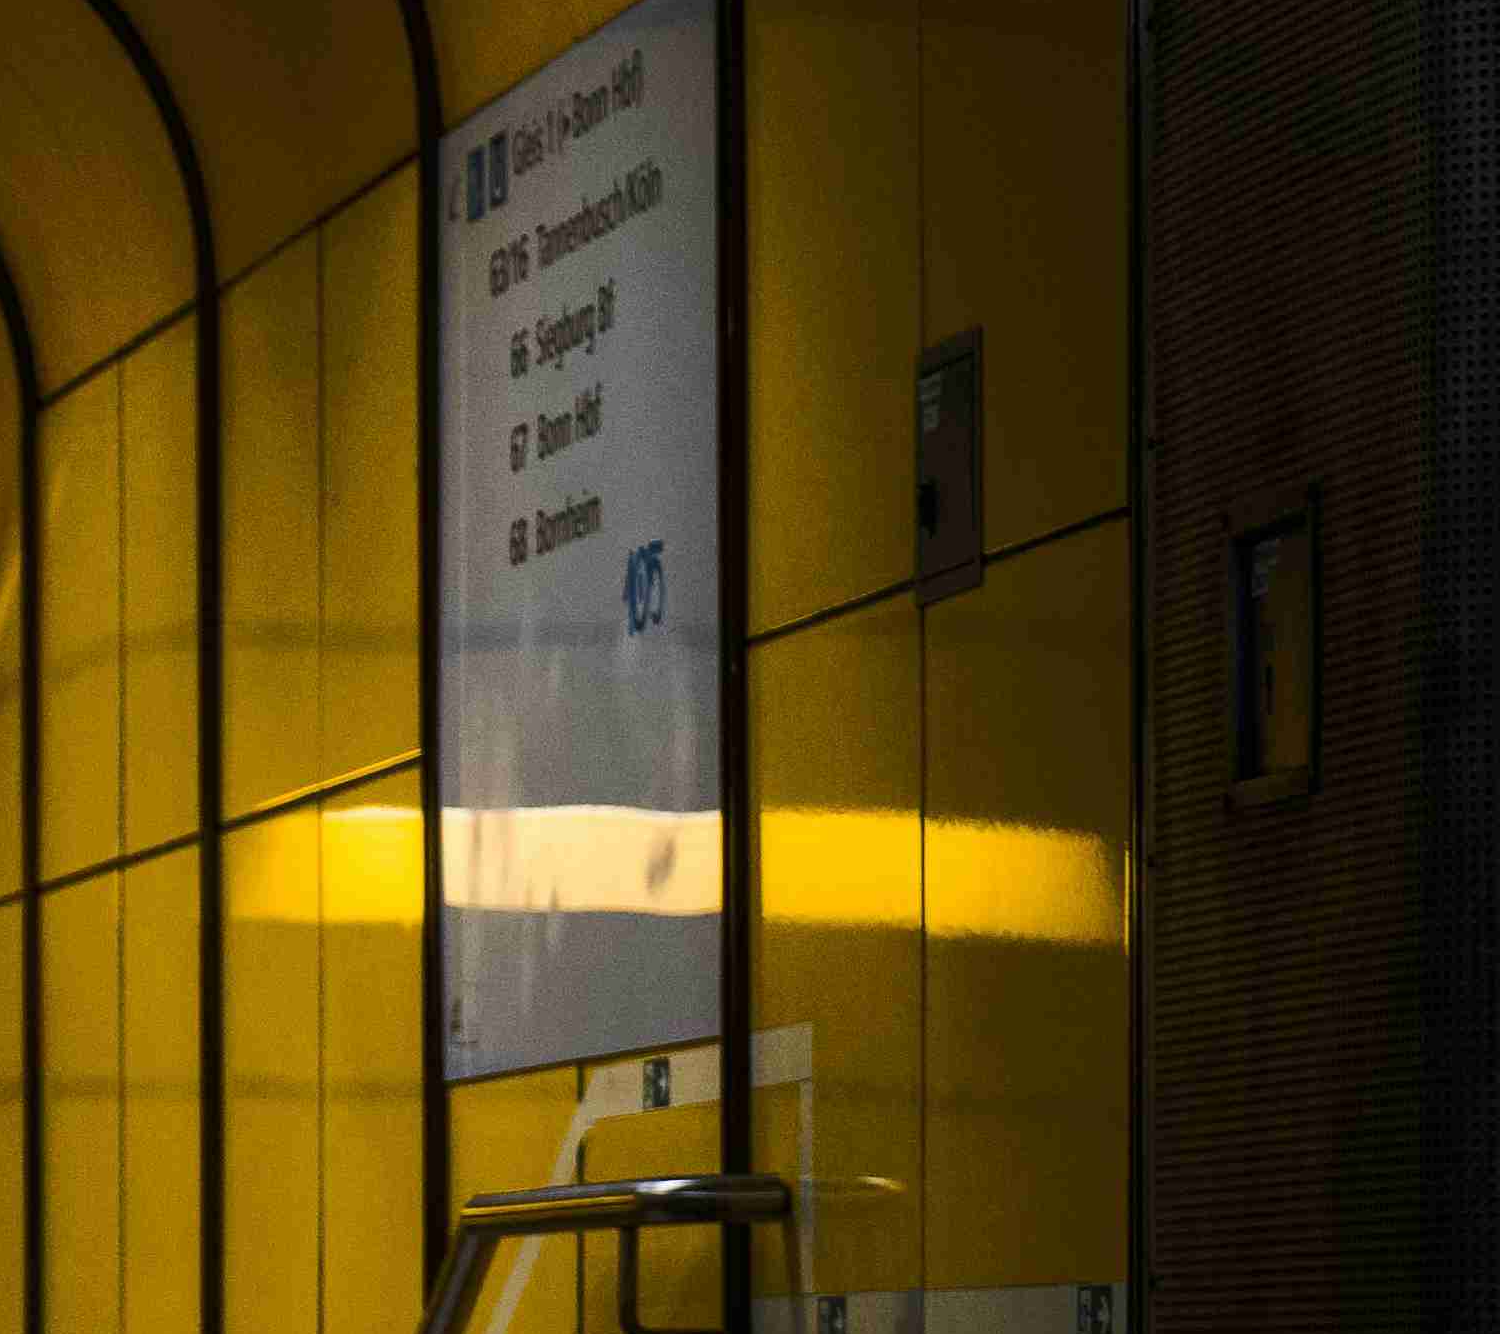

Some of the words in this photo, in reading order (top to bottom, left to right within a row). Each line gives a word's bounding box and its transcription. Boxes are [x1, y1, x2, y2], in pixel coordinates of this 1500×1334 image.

[512, 119, 544, 176] Gleis
[490, 233, 529, 299] 63/16
[510, 328, 529, 379] 66
[535, 302, 596, 371] Siegburg
[597, 276, 615, 335] Bf
[510, 422, 528, 472] 67
[536, 412, 572, 460] Bonn
[574, 381, 602, 444] Hbf
[509, 517, 528, 567] 68
[535, 489, 604, 556] Bornheim
